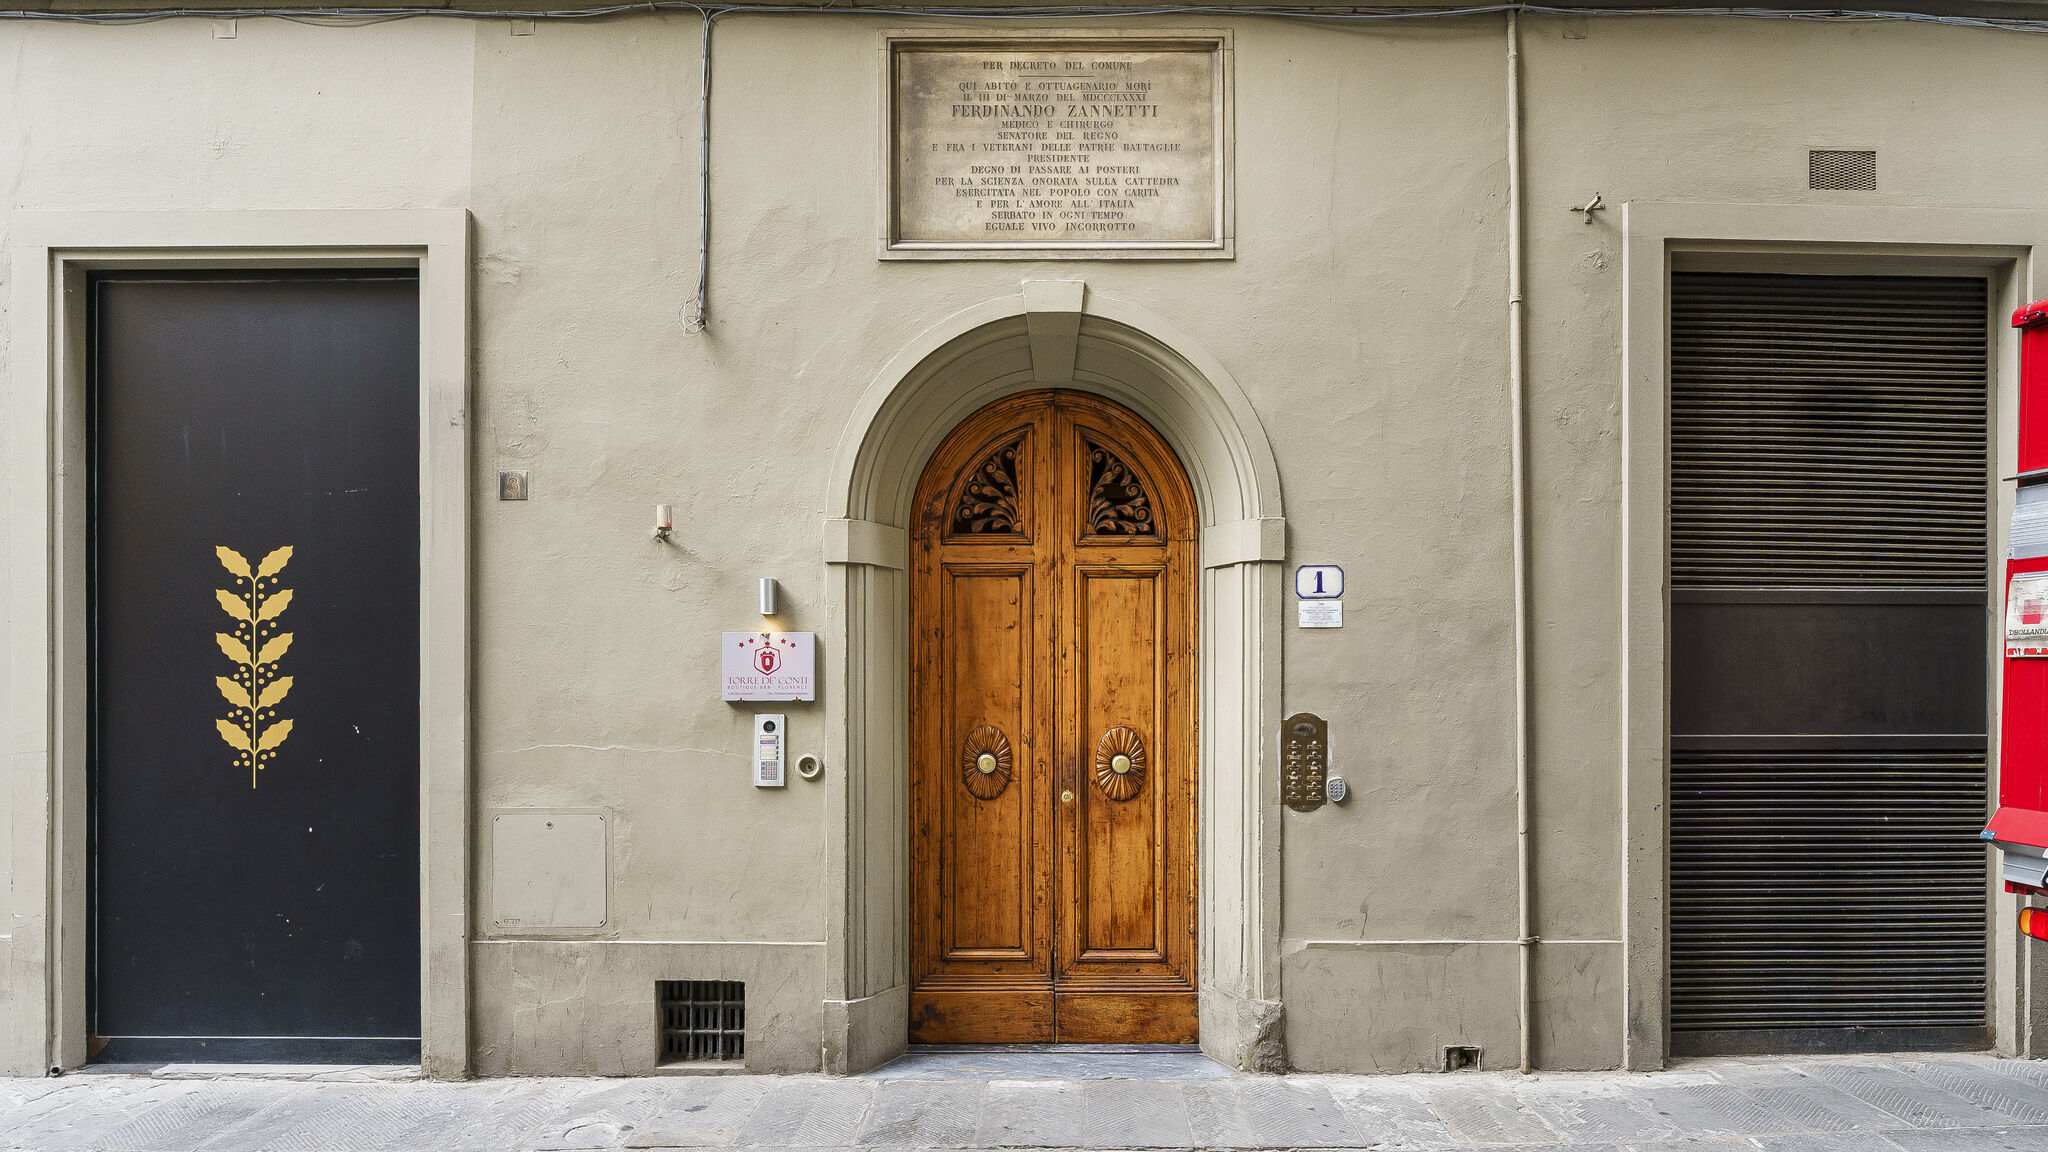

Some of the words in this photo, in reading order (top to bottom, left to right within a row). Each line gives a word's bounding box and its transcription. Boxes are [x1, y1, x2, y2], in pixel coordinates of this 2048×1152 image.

[983, 61, 1004, 71] PER
[1010, 61, 1056, 71] DECRETO
[1065, 61, 1085, 71] DEL
[1091, 61, 1133, 71] COMUNE
[959, 82, 977, 92] QUI
[1025, 82, 1031, 91] E
[1039, 82, 1117, 92] OTTUAGENARIO
[963, 93, 973, 101] IL
[979, 93, 990, 101] III
[996, 93, 1007, 101] DI
[1015, 93, 1049, 102] MARZO
[1056, 93, 1076, 102] DEL
[1082, 93, 1147, 102] MDCCCLXXXI
[952, 104, 1055, 119] FERDINANDO
[1068, 104, 1158, 118] ZANNETTI
[1001, 120, 1039, 130] MEDICO
[1047, 120, 1053, 129] E
[1060, 120, 1114, 130] CHIRURGO
[997, 131, 1048, 141] SENATORE
[1056, 131, 1075, 140] DEL
[1083, 131, 1119, 140] REGNO
[932, 143, 939, 152] E
[946, 143, 966, 153] FRA
[972, 143, 976, 152] I
[983, 143, 1033, 152] VETERANI
[1041, 143, 1072, 152] DELLE
[1079, 143, 1115, 152] PATRIE
[1123, 143, 1181, 152] BATTAGLIE
[1027, 154, 1090, 163] PRESIDENTE
[971, 165, 1005, 174] DEGNO
[1010, 165, 1021, 174] DI
[1029, 165, 1072, 174] PASSARE
[1078, 165, 1089, 174] AI
[1096, 165, 1139, 175] POSTERI
[935, 177, 954, 186] PER
[961, 177, 974, 186] LA
[981, 177, 1024, 186] SCIENZA
[1032, 177, 1079, 186] ONORATA
[1086, 177, 1118, 186] SULLA
[1125, 177, 1181, 187] CATTEDRA
[955, 188, 1017, 198] ESERCITATA
[1022, 188, 1042, 197] NEL
[1050, 188, 1091, 197] POPOLO
[1097, 188, 1119, 197] CON
[976, 200, 983, 209] E
[990, 200, 1010, 209] PER
[1029, 200, 1063, 209] AMORE
[1099, 200, 1135, 209] ITALIA
[991, 211, 1036, 220] SERBATO
[1042, 211, 1053, 220] IN
[1059, 211, 1085, 220] OGNI
[1091, 211, 1124, 220] TEMPO
[985, 222, 1025, 232] EGUALE
[1031, 222, 1056, 232] VIVO
[1066, 222, 1136, 233] INCORROTTO
[1312, 570, 1327, 594] 1
[728, 676, 759, 685] TORRE
[778, 676, 807, 685] CONTI
